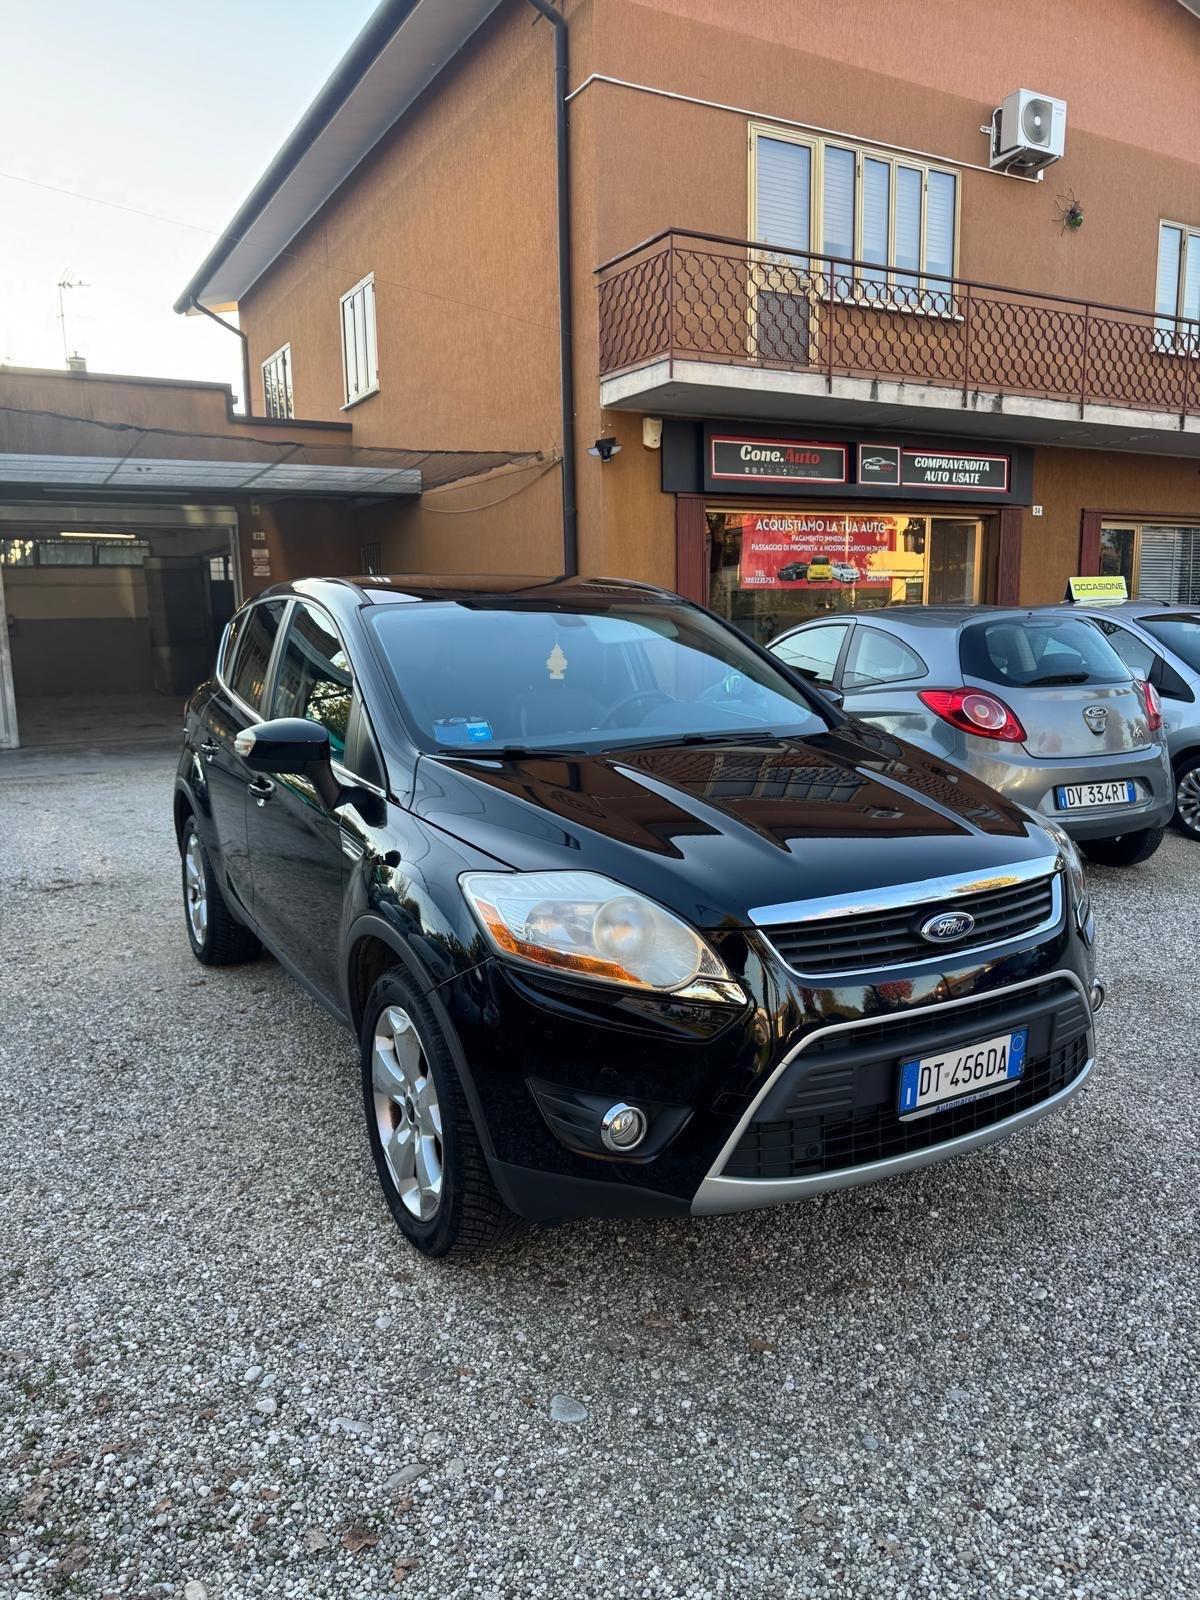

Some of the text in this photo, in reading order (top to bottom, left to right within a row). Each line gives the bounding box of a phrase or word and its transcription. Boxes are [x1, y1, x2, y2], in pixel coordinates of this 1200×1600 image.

[914, 456, 990, 472] COMPRAVENDITA
[924, 471, 980, 484] AUTO USATE
[755, 519, 887, 533] ACQUISTIAMO LA TUA AUTO
[791, 534, 824, 542] PAGAMENTO
[751, 543, 782, 551] PASSAGGIO
[1073, 582, 1125, 591] OCCASIONE
[1091, 708, 1105, 716] Ford
[1066, 787, 1083, 806] DV
[1087, 783, 1127, 803] 334RT
[937, 918, 965, 937] Ford
[918, 1061, 945, 1097] DT
[949, 1045, 1008, 1087] 456DA
[935, 1094, 977, 1113] Automarca
